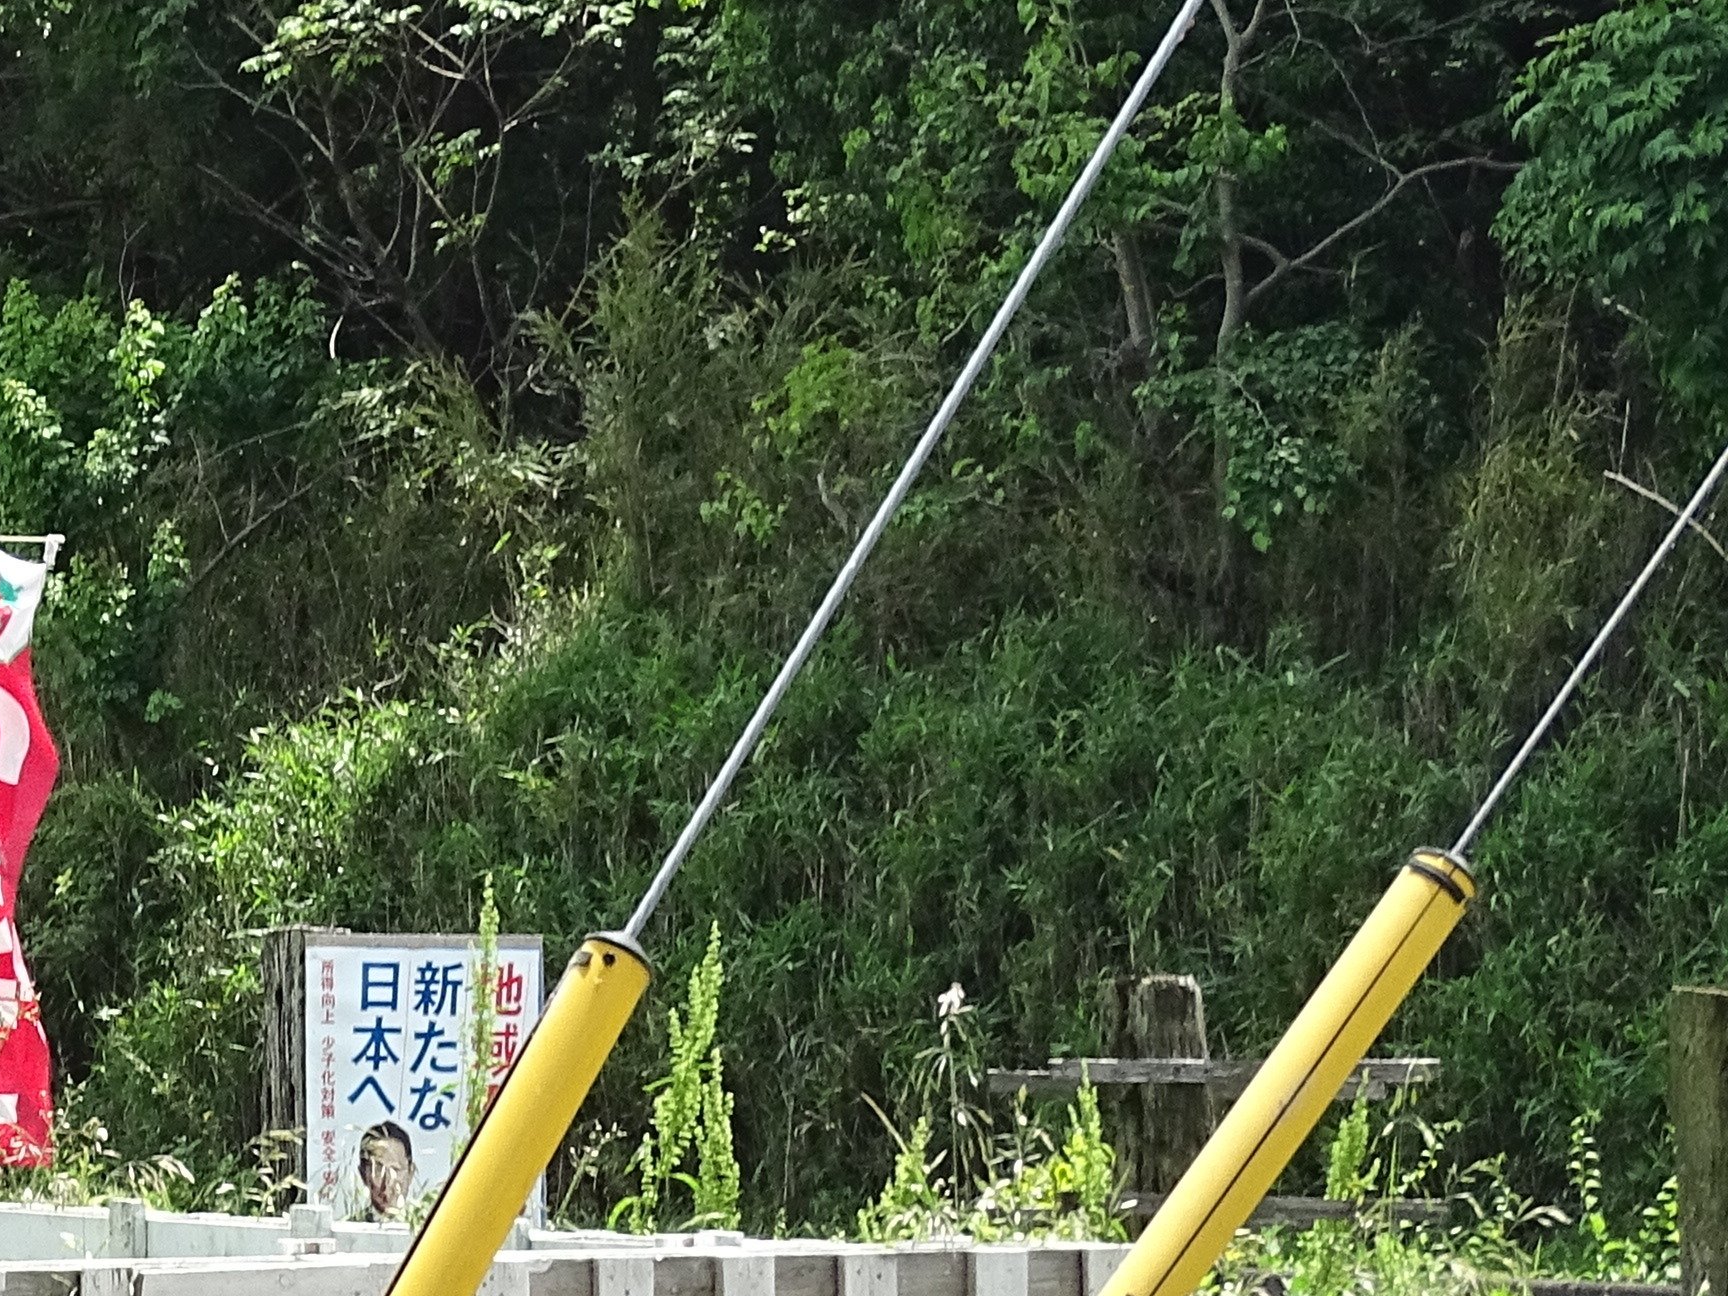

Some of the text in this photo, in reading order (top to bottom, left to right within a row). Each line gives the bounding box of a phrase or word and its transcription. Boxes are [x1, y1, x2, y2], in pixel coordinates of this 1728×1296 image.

[347, 961, 402, 1115] 日本へ
[408, 960, 464, 1131] 新たな
